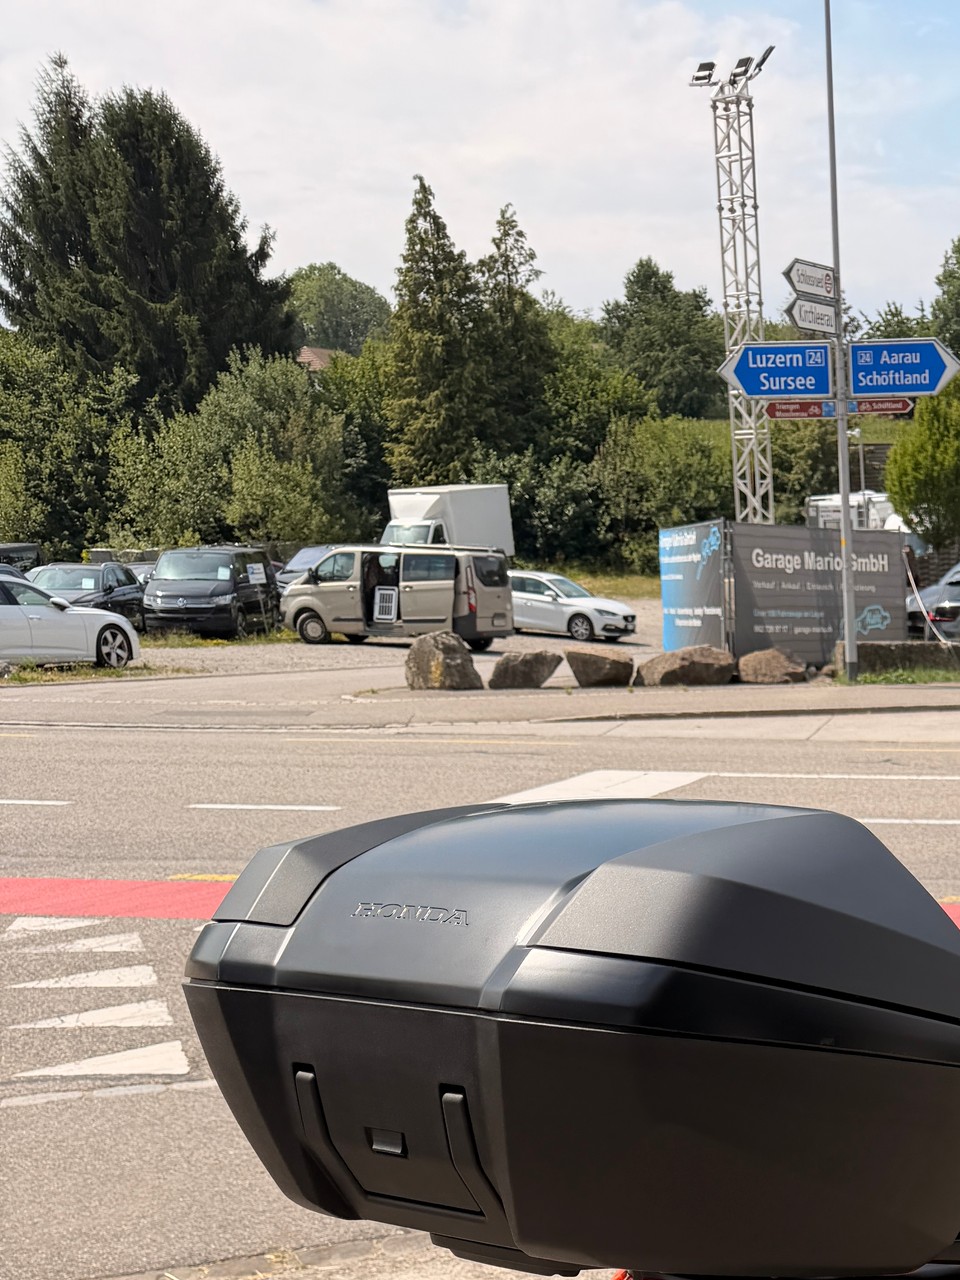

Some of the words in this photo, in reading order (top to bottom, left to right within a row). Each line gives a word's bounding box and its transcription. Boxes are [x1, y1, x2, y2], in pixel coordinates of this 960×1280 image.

[748, 350, 803, 368] Luzern
[808, 351, 822, 365] 24
[859, 353, 872, 364] 24
[880, 350, 920, 364] Aarau
[759, 373, 816, 391] Sursee
[858, 370, 930, 387] Schöftland
[751, 548, 801, 574] Garage
[803, 550, 843, 572] Mario
[351, 902, 469, 926] HONDA
